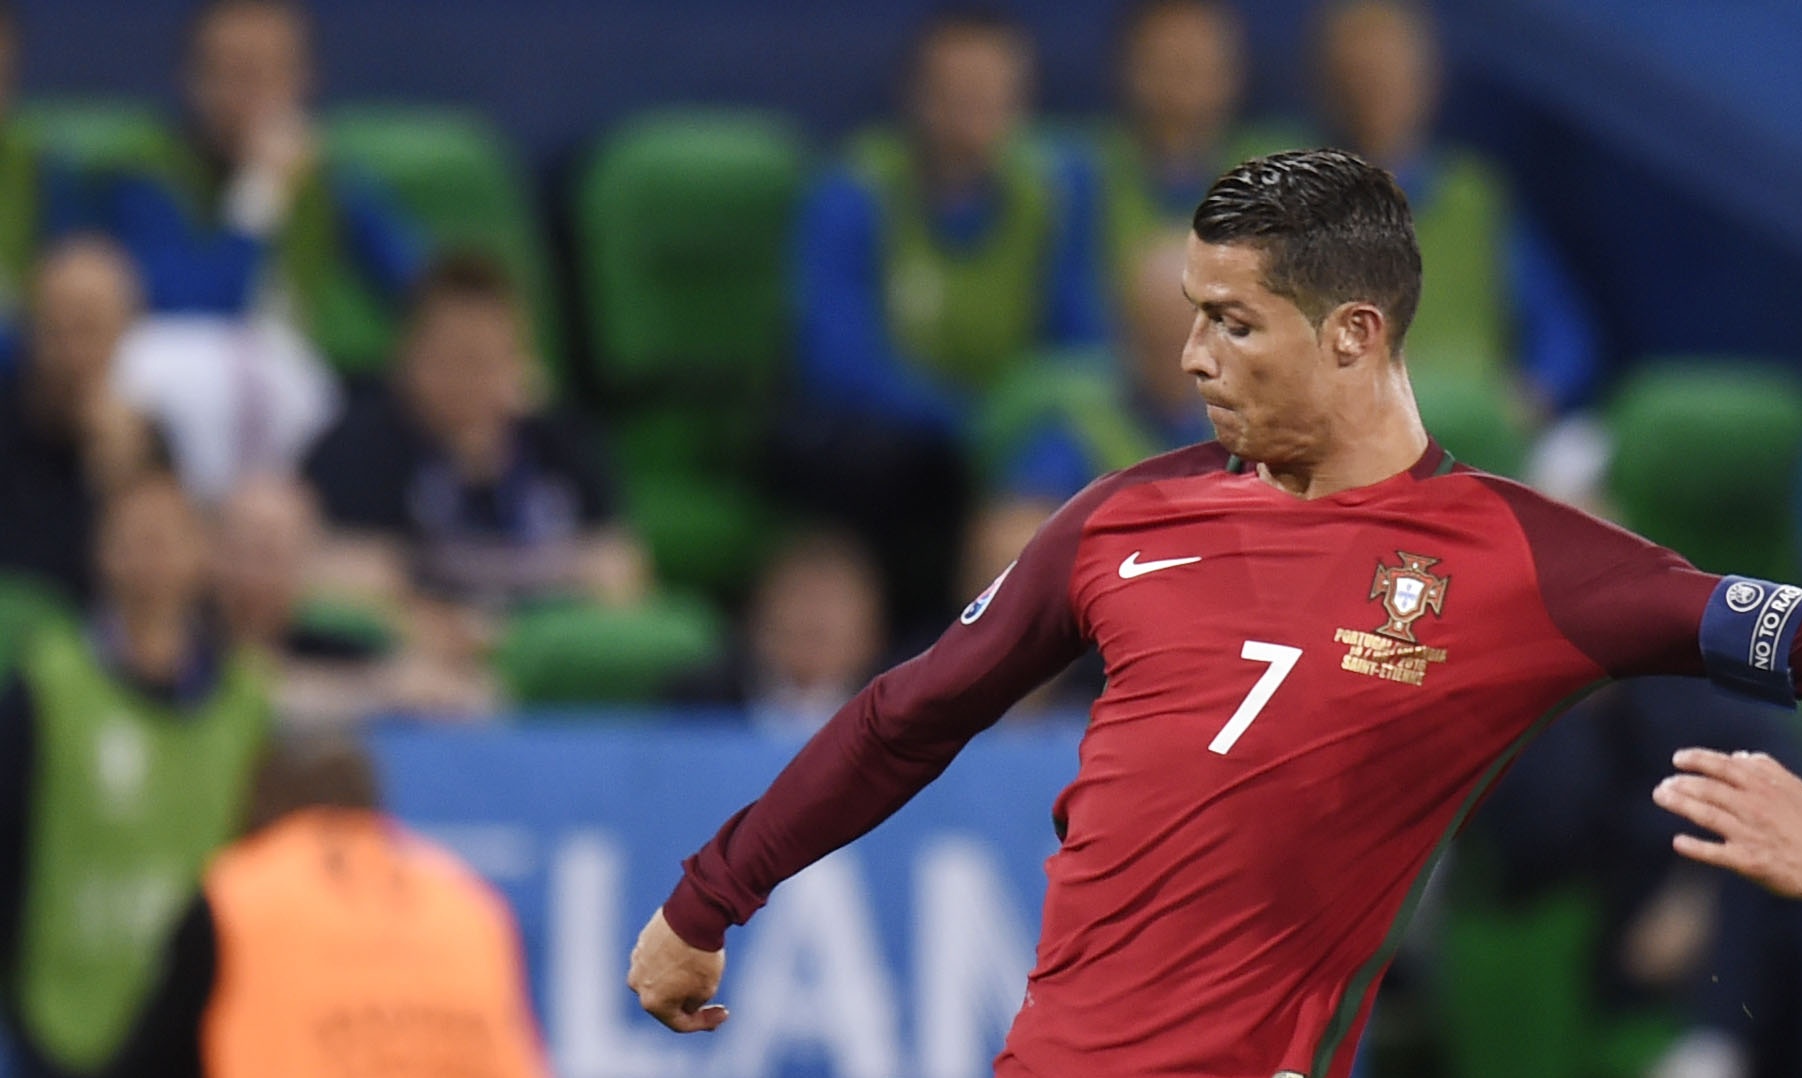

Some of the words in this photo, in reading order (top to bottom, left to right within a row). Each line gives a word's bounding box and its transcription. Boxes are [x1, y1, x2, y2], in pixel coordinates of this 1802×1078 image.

[1759, 612, 1780, 637] TO
[1755, 641, 1771, 670] NO
[1207, 639, 1304, 756] 7
